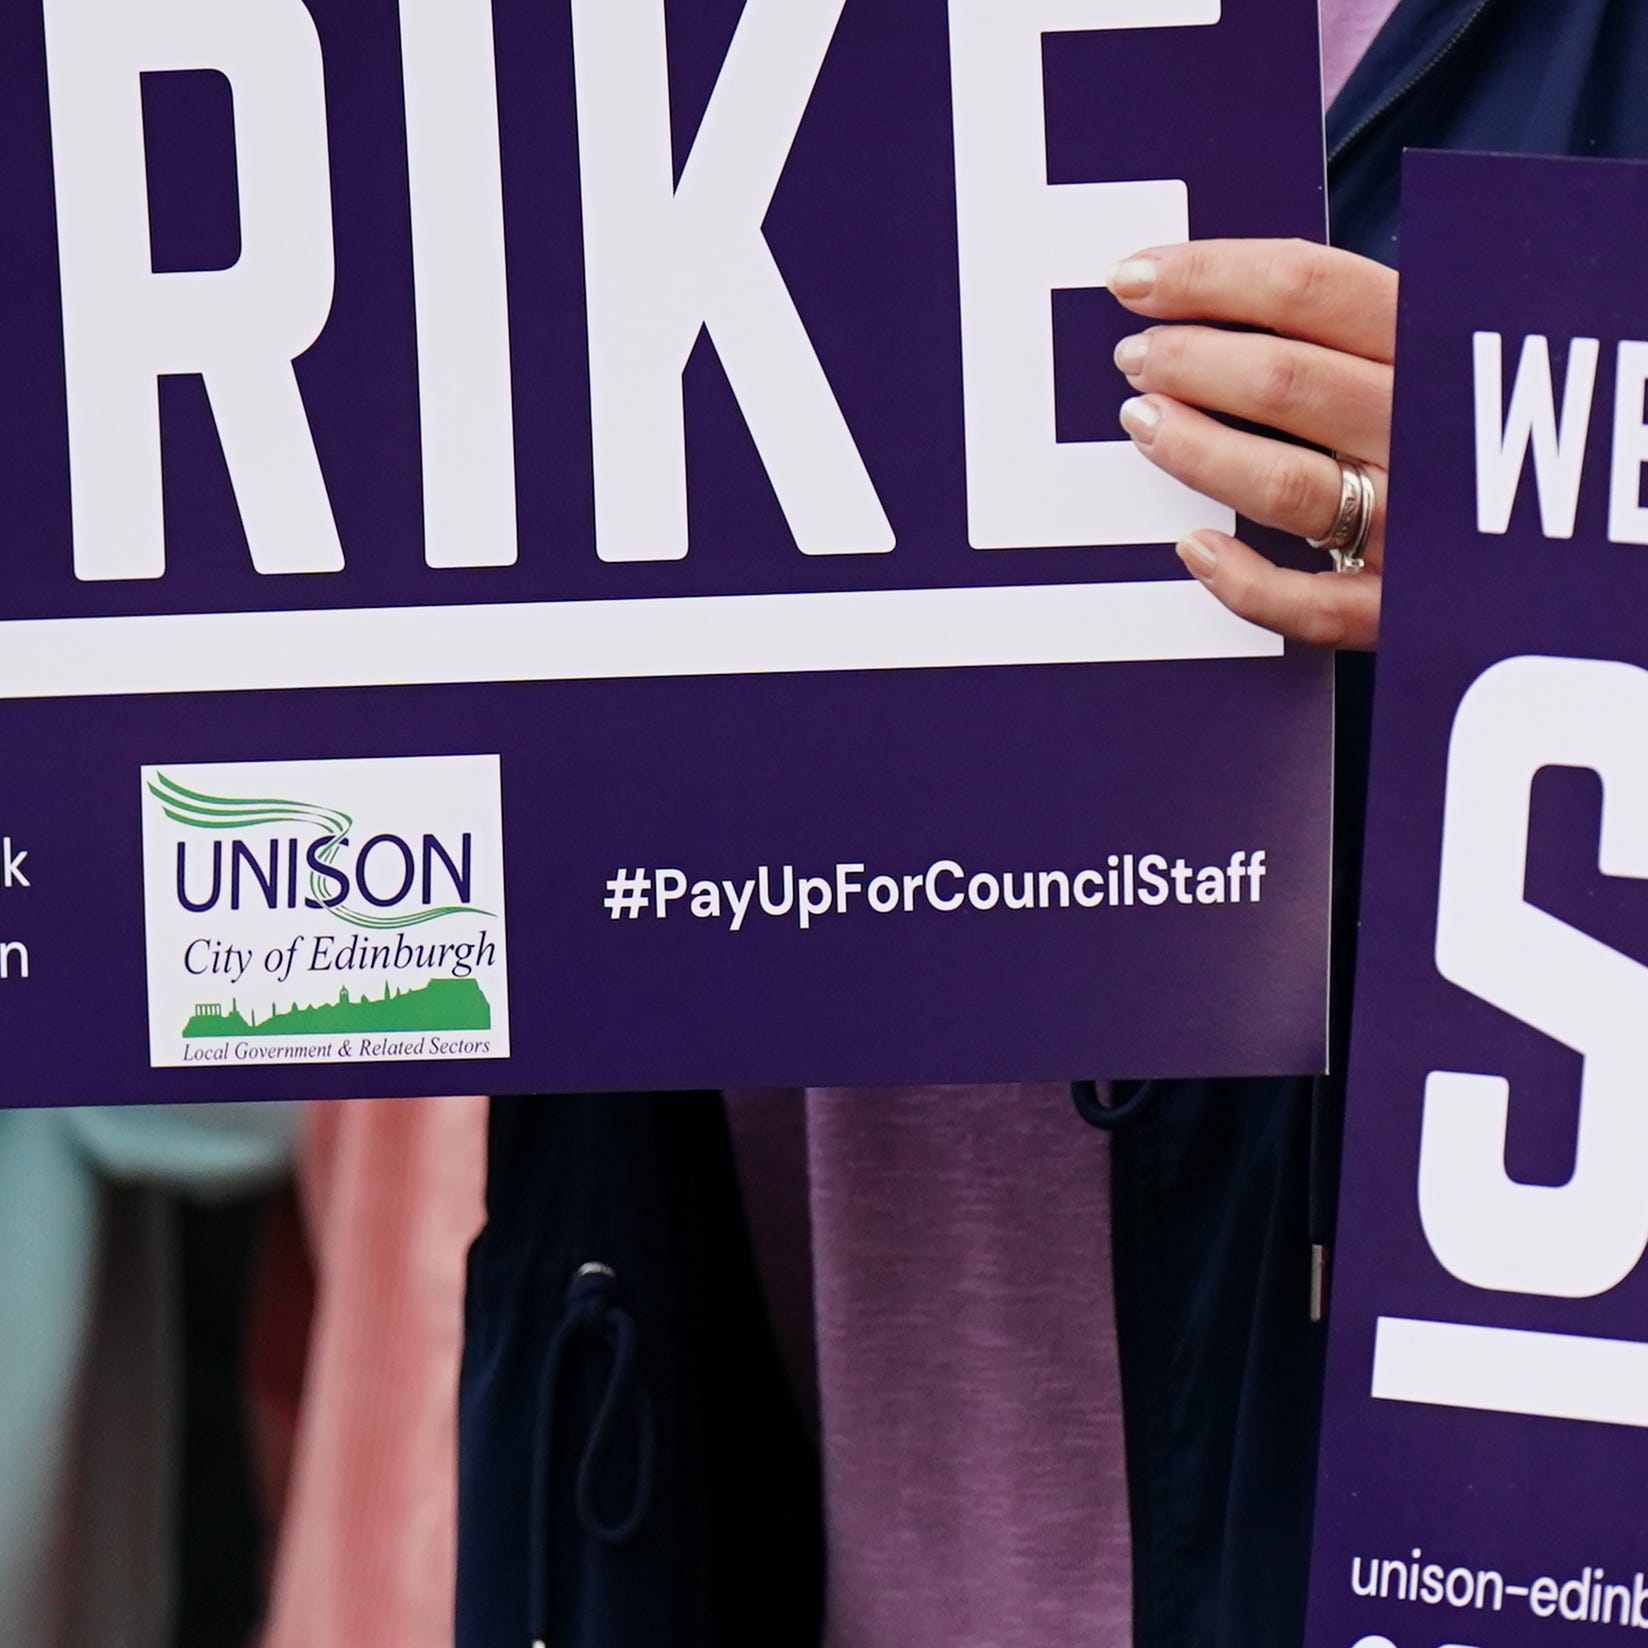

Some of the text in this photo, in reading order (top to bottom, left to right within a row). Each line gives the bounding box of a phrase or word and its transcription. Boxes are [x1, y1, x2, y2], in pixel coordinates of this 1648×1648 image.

[176, 832, 472, 913] UNISON
[602, 849, 1267, 931] #PayUpForCouncilStaff
[183, 930, 496, 983] City of Edinburgh
[183, 1036, 491, 1061] Local Government & Related Sectors
